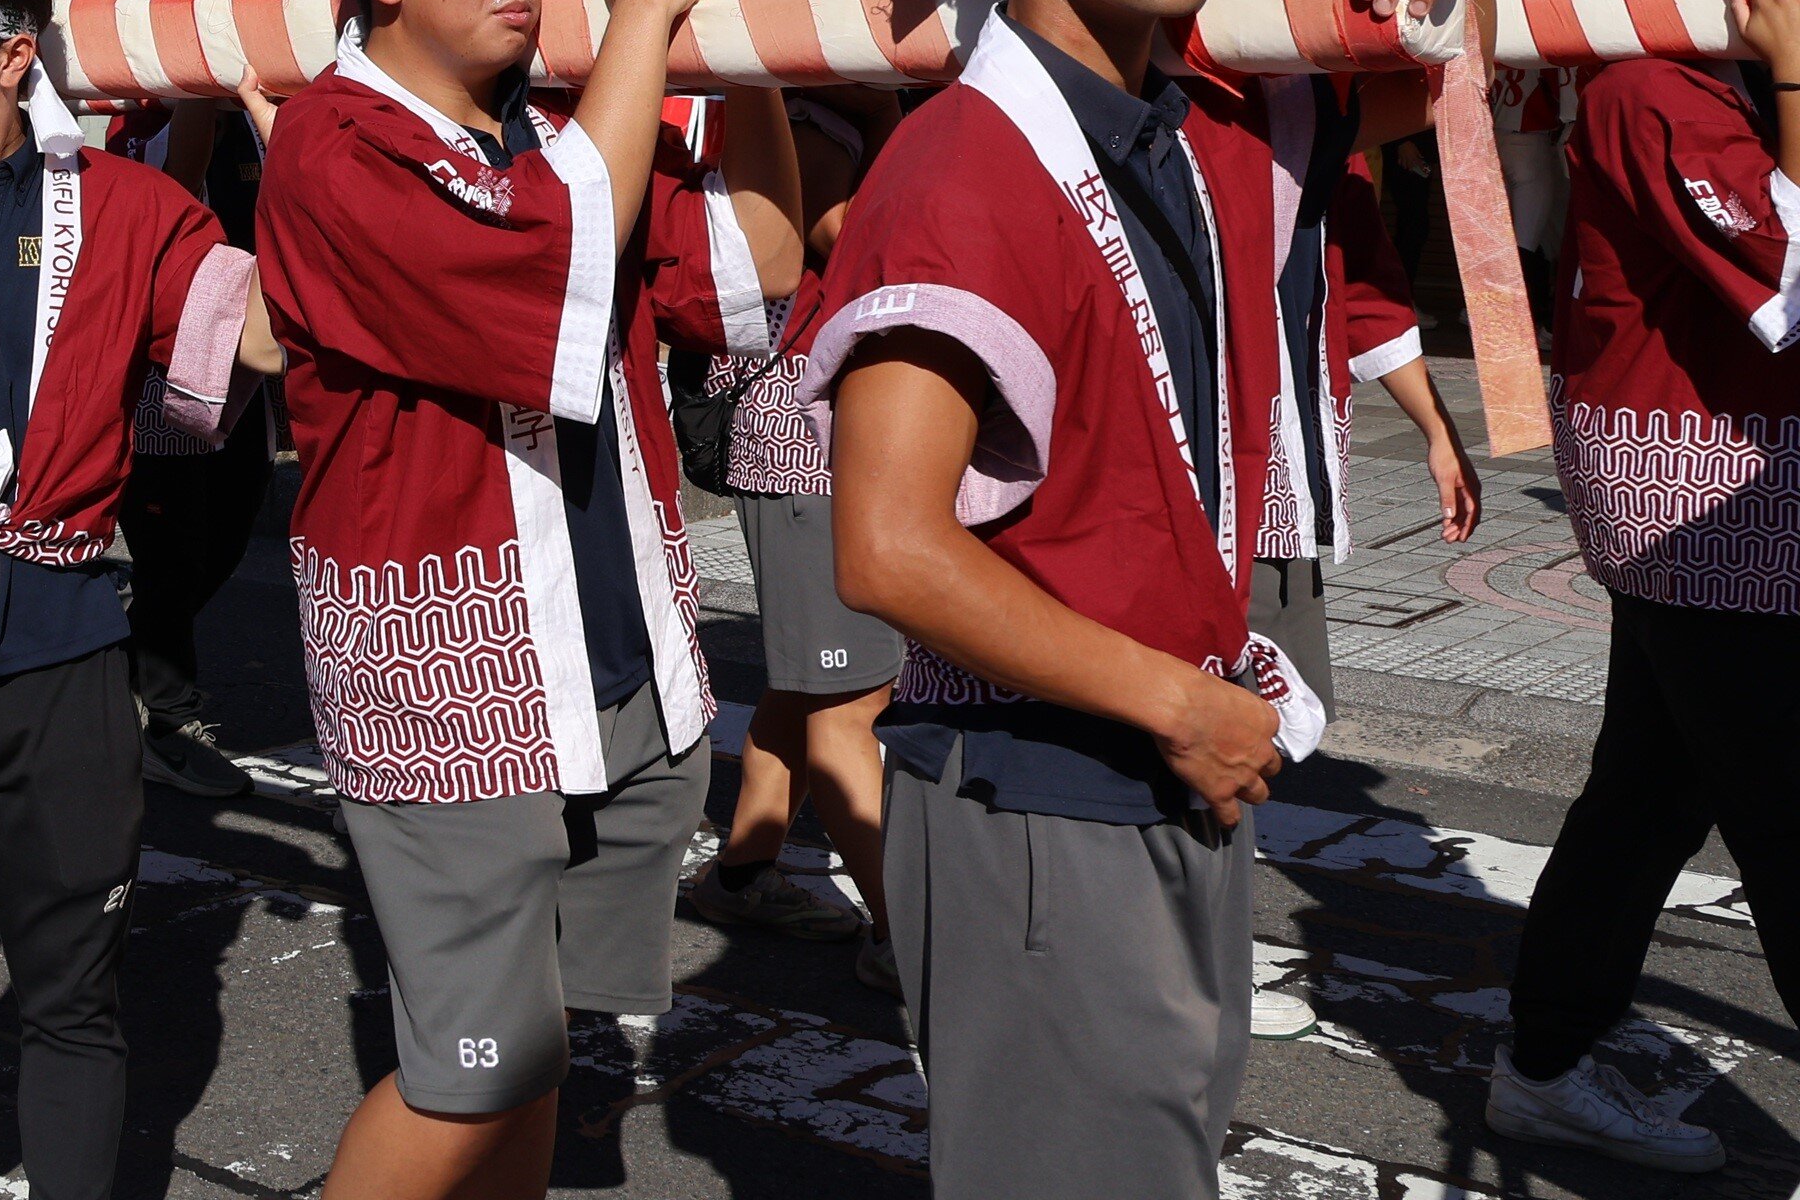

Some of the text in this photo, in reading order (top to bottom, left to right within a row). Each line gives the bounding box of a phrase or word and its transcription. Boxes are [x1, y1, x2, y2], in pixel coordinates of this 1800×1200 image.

[52, 169, 74, 215] GIFU
[820, 648, 848, 669] 80
[458, 1037, 500, 1069] 63
